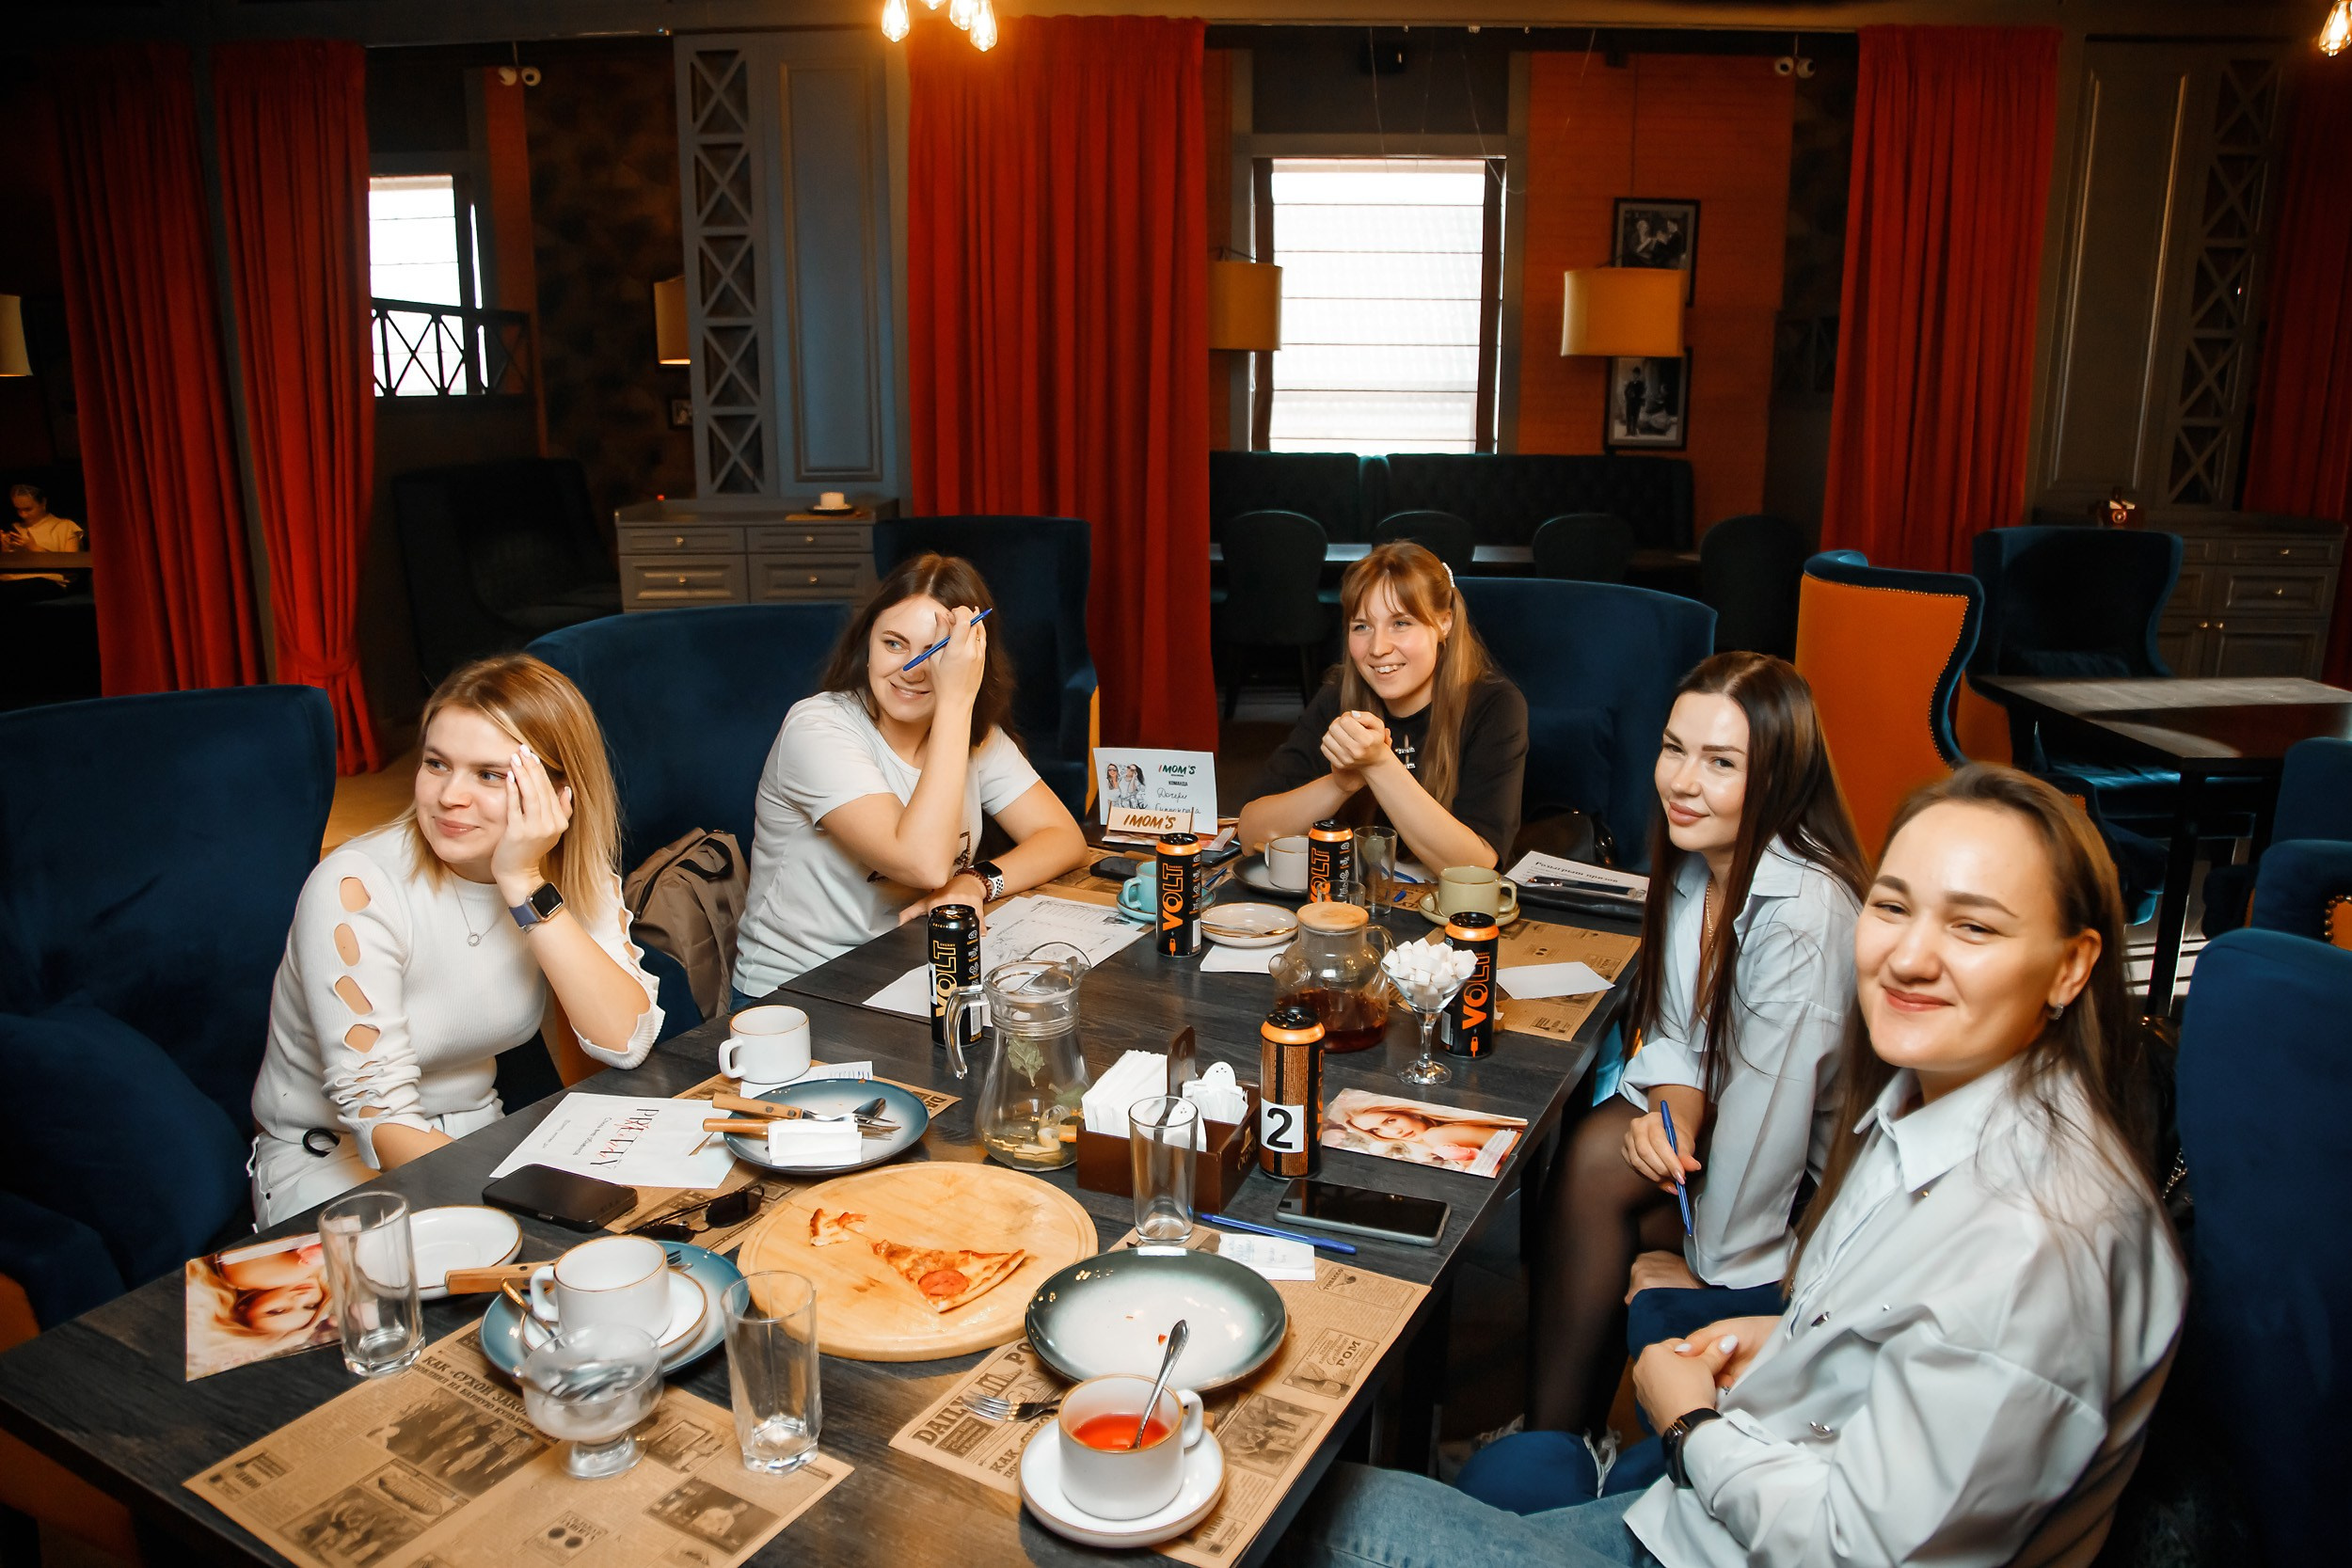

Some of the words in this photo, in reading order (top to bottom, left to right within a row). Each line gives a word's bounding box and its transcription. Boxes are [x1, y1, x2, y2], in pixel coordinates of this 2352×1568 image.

[1162, 863, 1184, 931] VOLT
[933, 940, 957, 1018] VOLT
[1266, 1107, 1294, 1149] 2
[1003, 1342, 1035, 1367] PO
[421, 1355, 452, 1372] КАК
[492, 1392, 528, 1416] ЗАКО
[989, 1449, 1020, 1474] КАК
